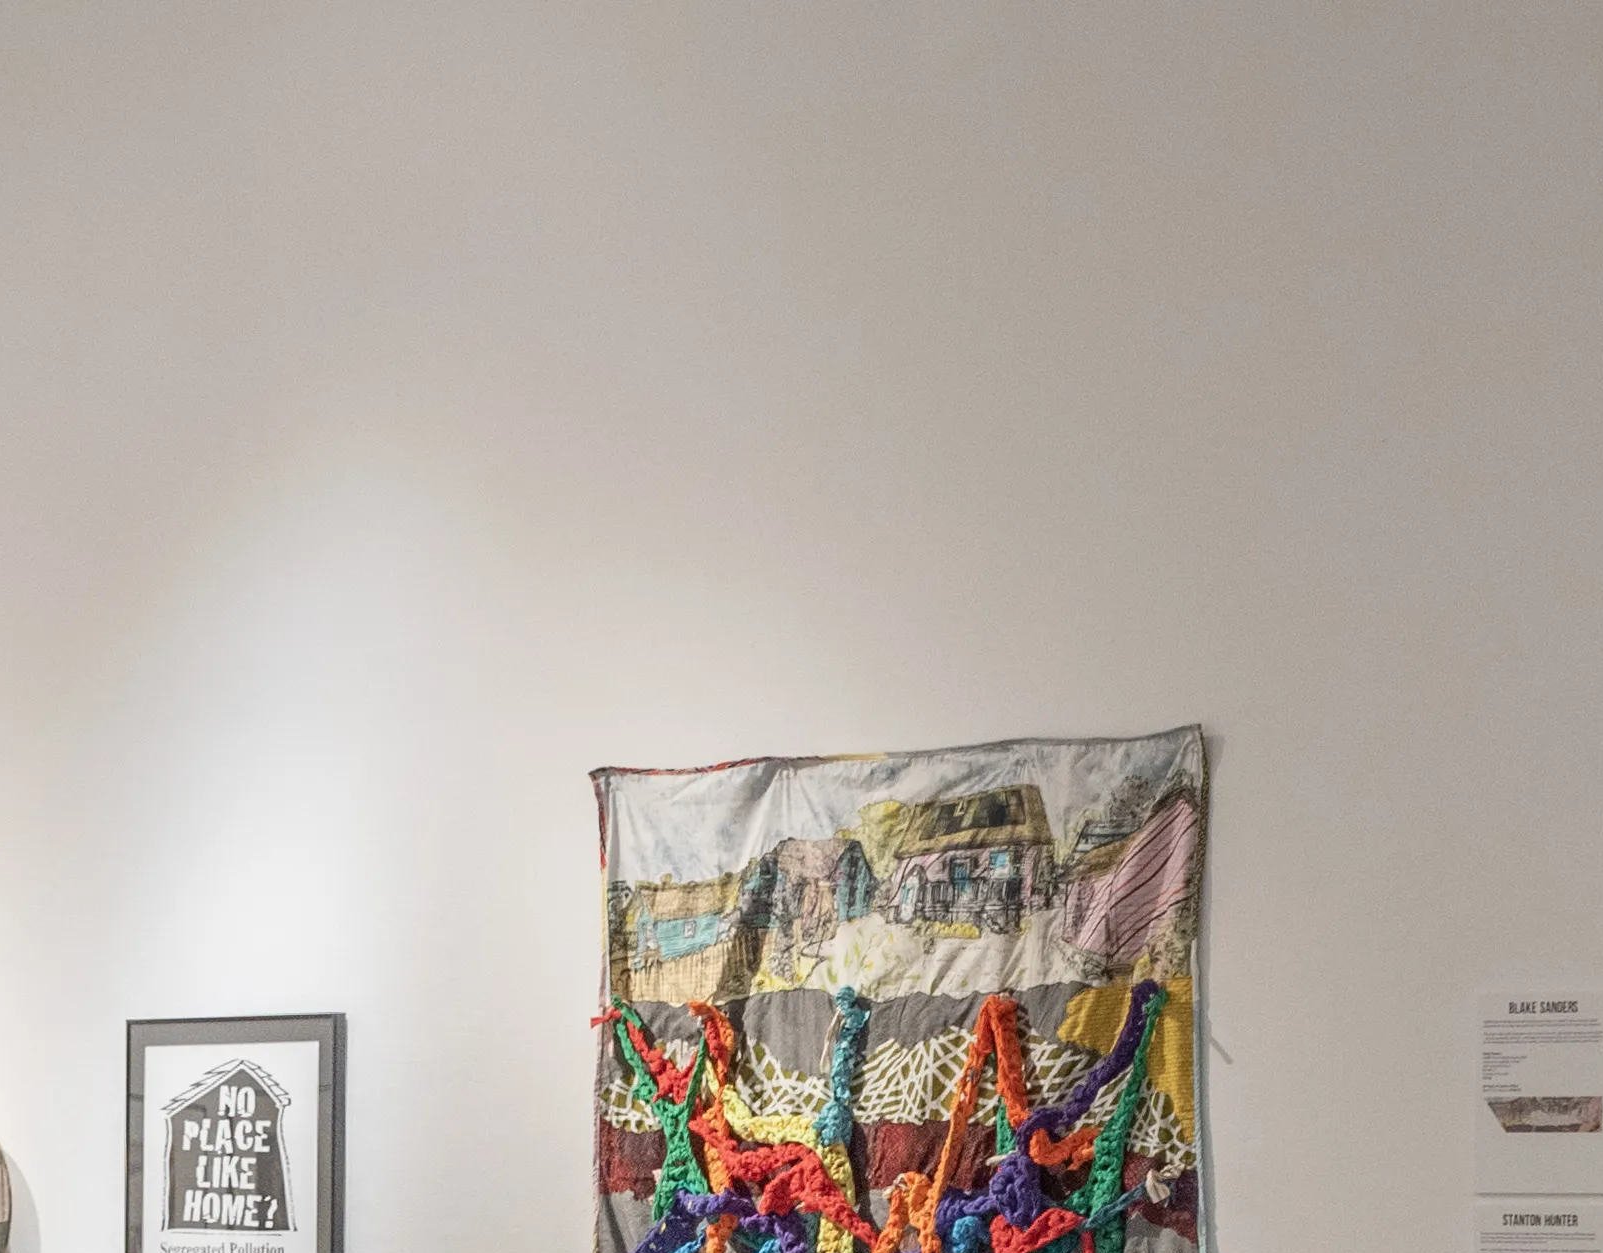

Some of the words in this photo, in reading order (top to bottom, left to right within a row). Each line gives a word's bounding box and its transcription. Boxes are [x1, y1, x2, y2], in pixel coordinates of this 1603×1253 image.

[1508, 1001, 1537, 1014] BLAKE
[1540, 1000, 1578, 1013] SANDERS
[217, 1085, 256, 1118] NO
[182, 1118, 272, 1154] PLACE
[196, 1155, 257, 1189] LIKE
[183, 1190, 278, 1228] HOME?
[1502, 1213, 1541, 1226] STANTON
[1544, 1213, 1578, 1226] HUNTER
